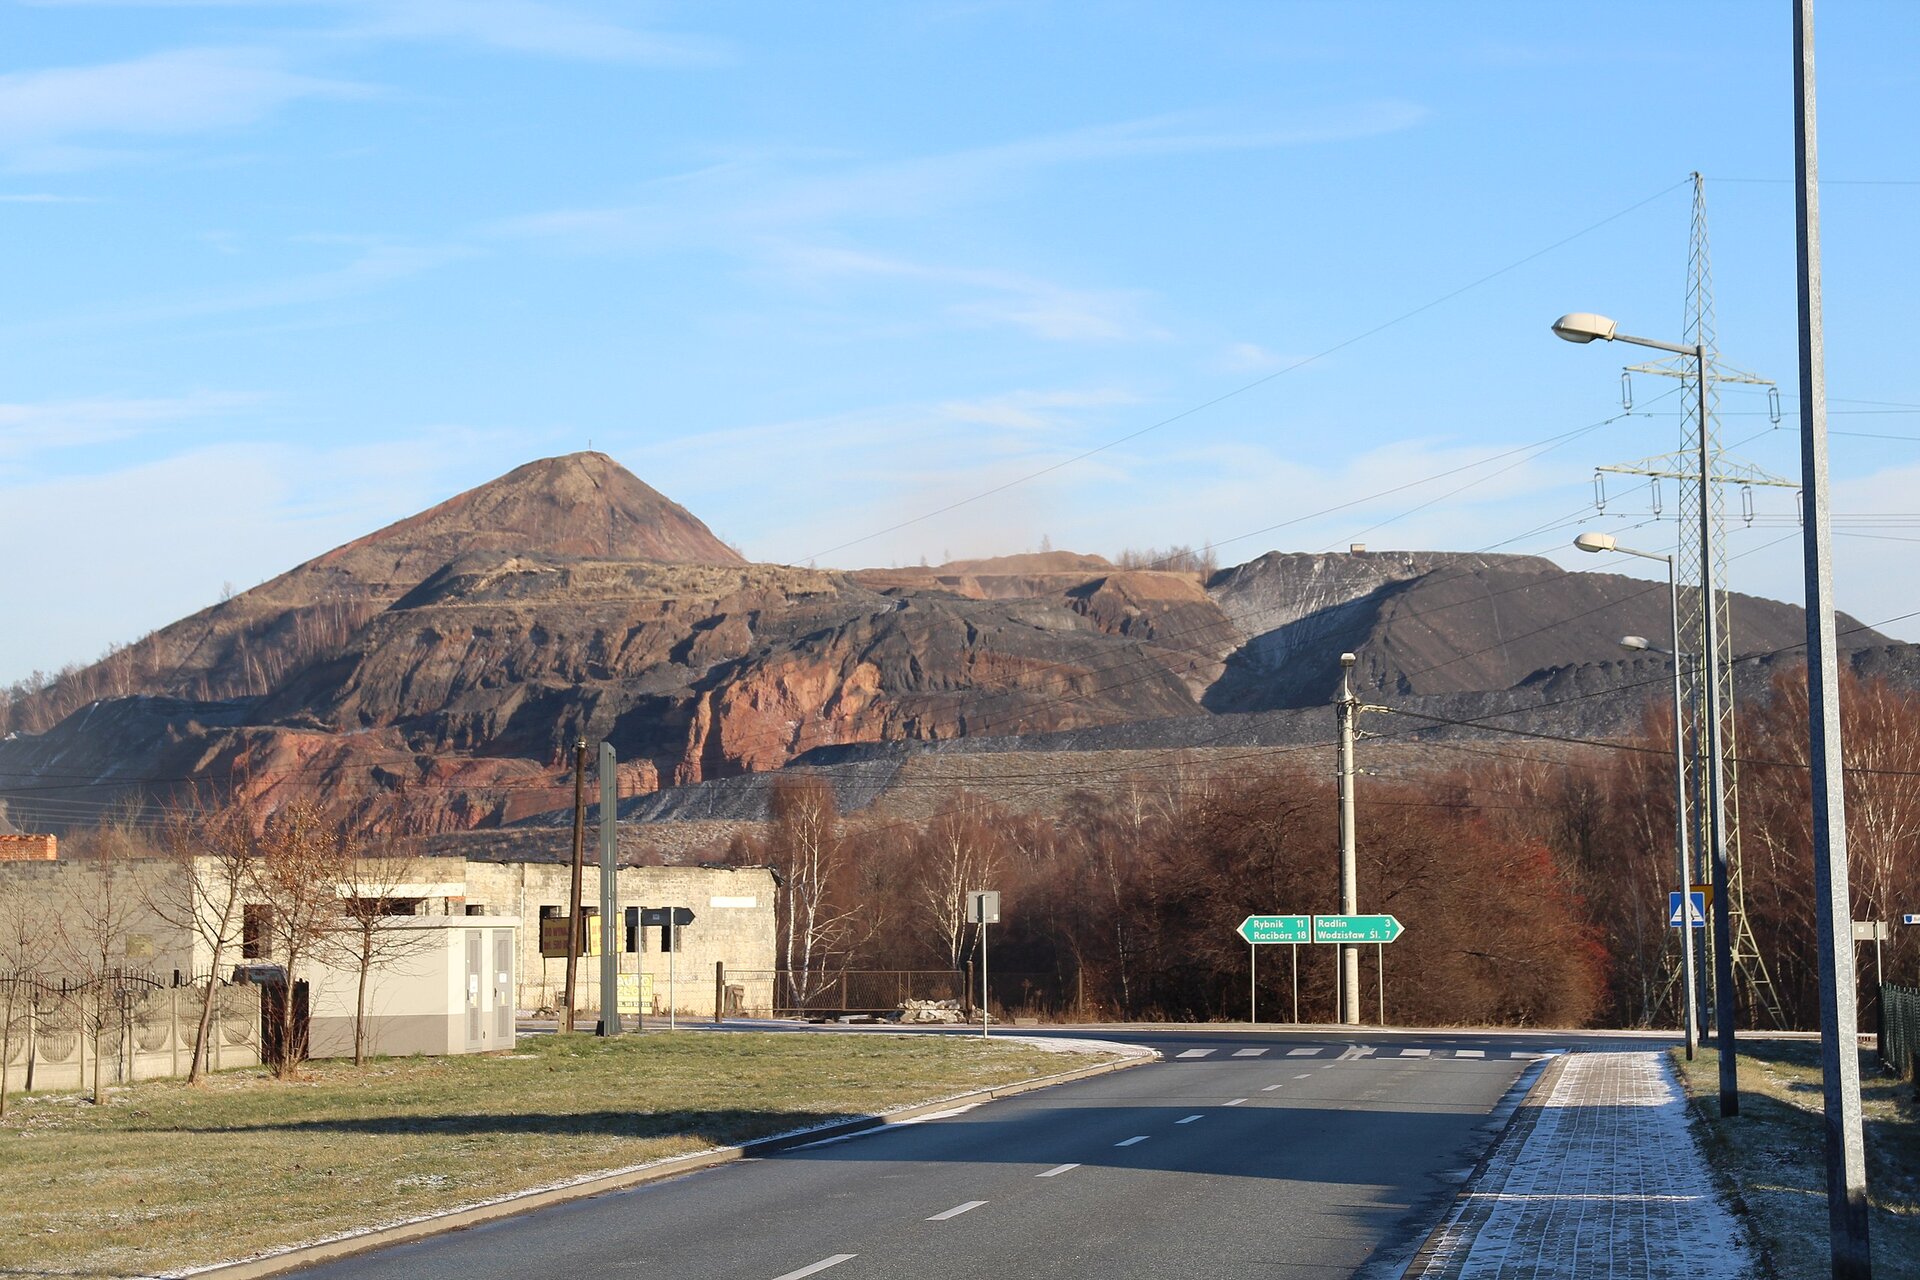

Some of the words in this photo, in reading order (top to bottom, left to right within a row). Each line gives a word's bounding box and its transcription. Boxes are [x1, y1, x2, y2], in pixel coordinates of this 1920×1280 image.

[1253, 919, 1284, 930] Rybnik
[1296, 919, 1304, 928] 11
[1318, 919, 1347, 928] Radlin
[1384, 919, 1391, 928] 3
[1254, 931, 1293, 940] Racibórz
[1297, 931, 1307, 940] 18
[1317, 930, 1365, 939] Wodzisław
[1385, 930, 1391, 939] 7
